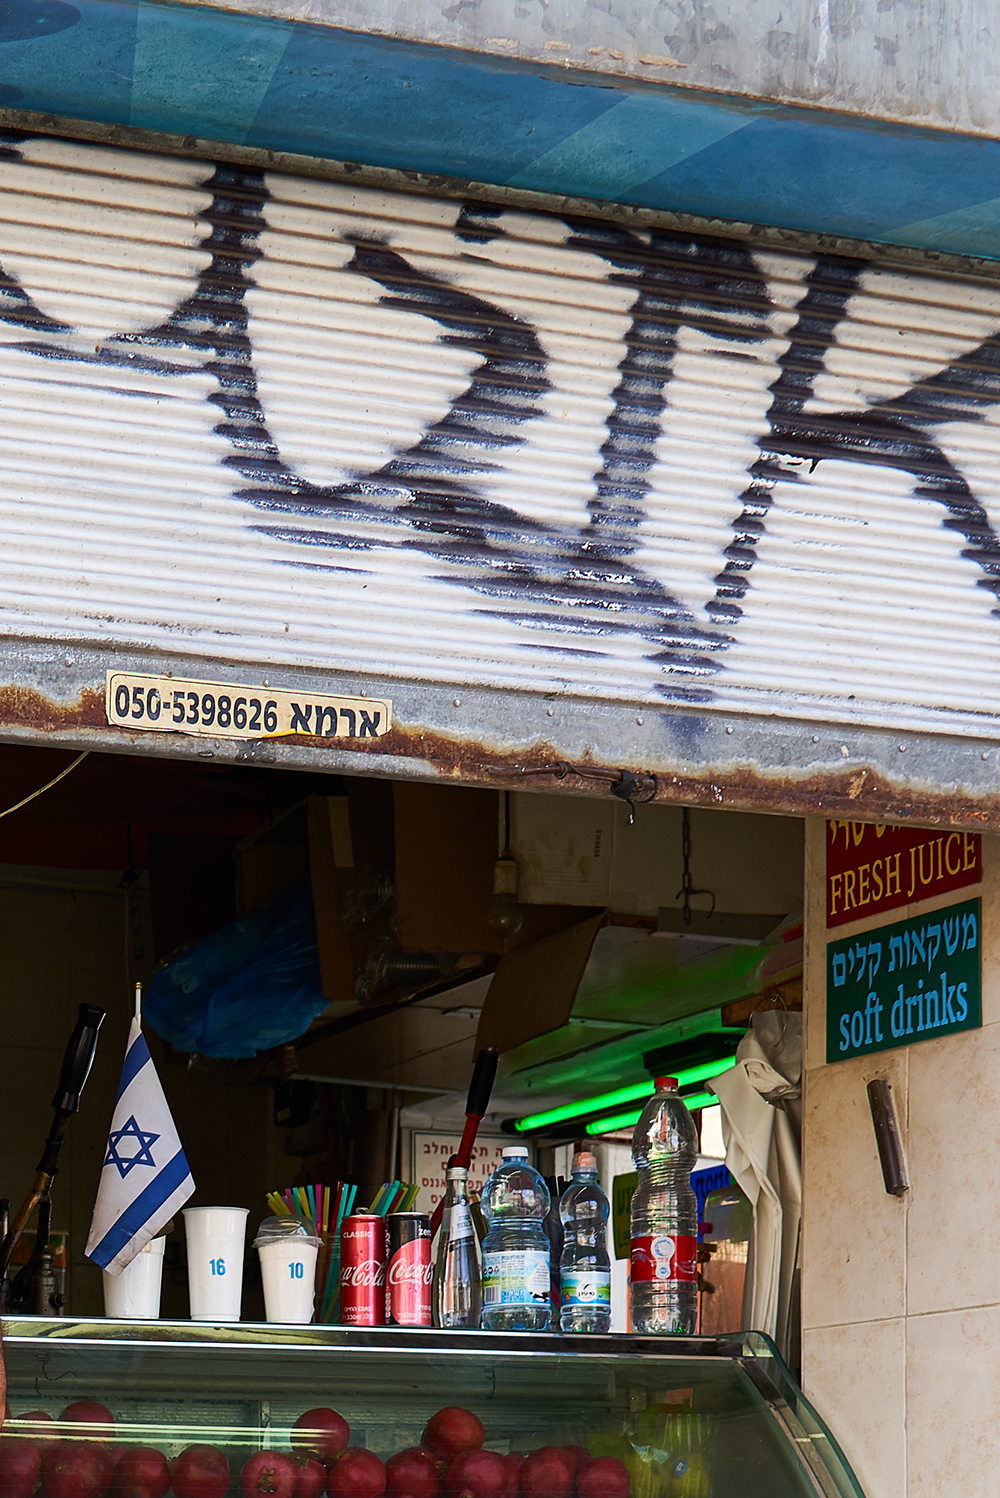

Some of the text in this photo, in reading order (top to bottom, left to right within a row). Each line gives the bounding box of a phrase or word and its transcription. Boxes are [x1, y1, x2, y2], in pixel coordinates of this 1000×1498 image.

[114, 684, 277, 732] 050-5398626
[830, 852, 902, 916] FRESH
[907, 830, 977, 898] JUICE
[832, 912, 978, 990] משקאות קלים
[839, 971, 968, 1052] soft drinks
[423, 1142, 454, 1155] וחלב
[343, 1229, 373, 1239] CLASSIC
[209, 1259, 226, 1275] 16
[288, 1262, 304, 1278] 10
